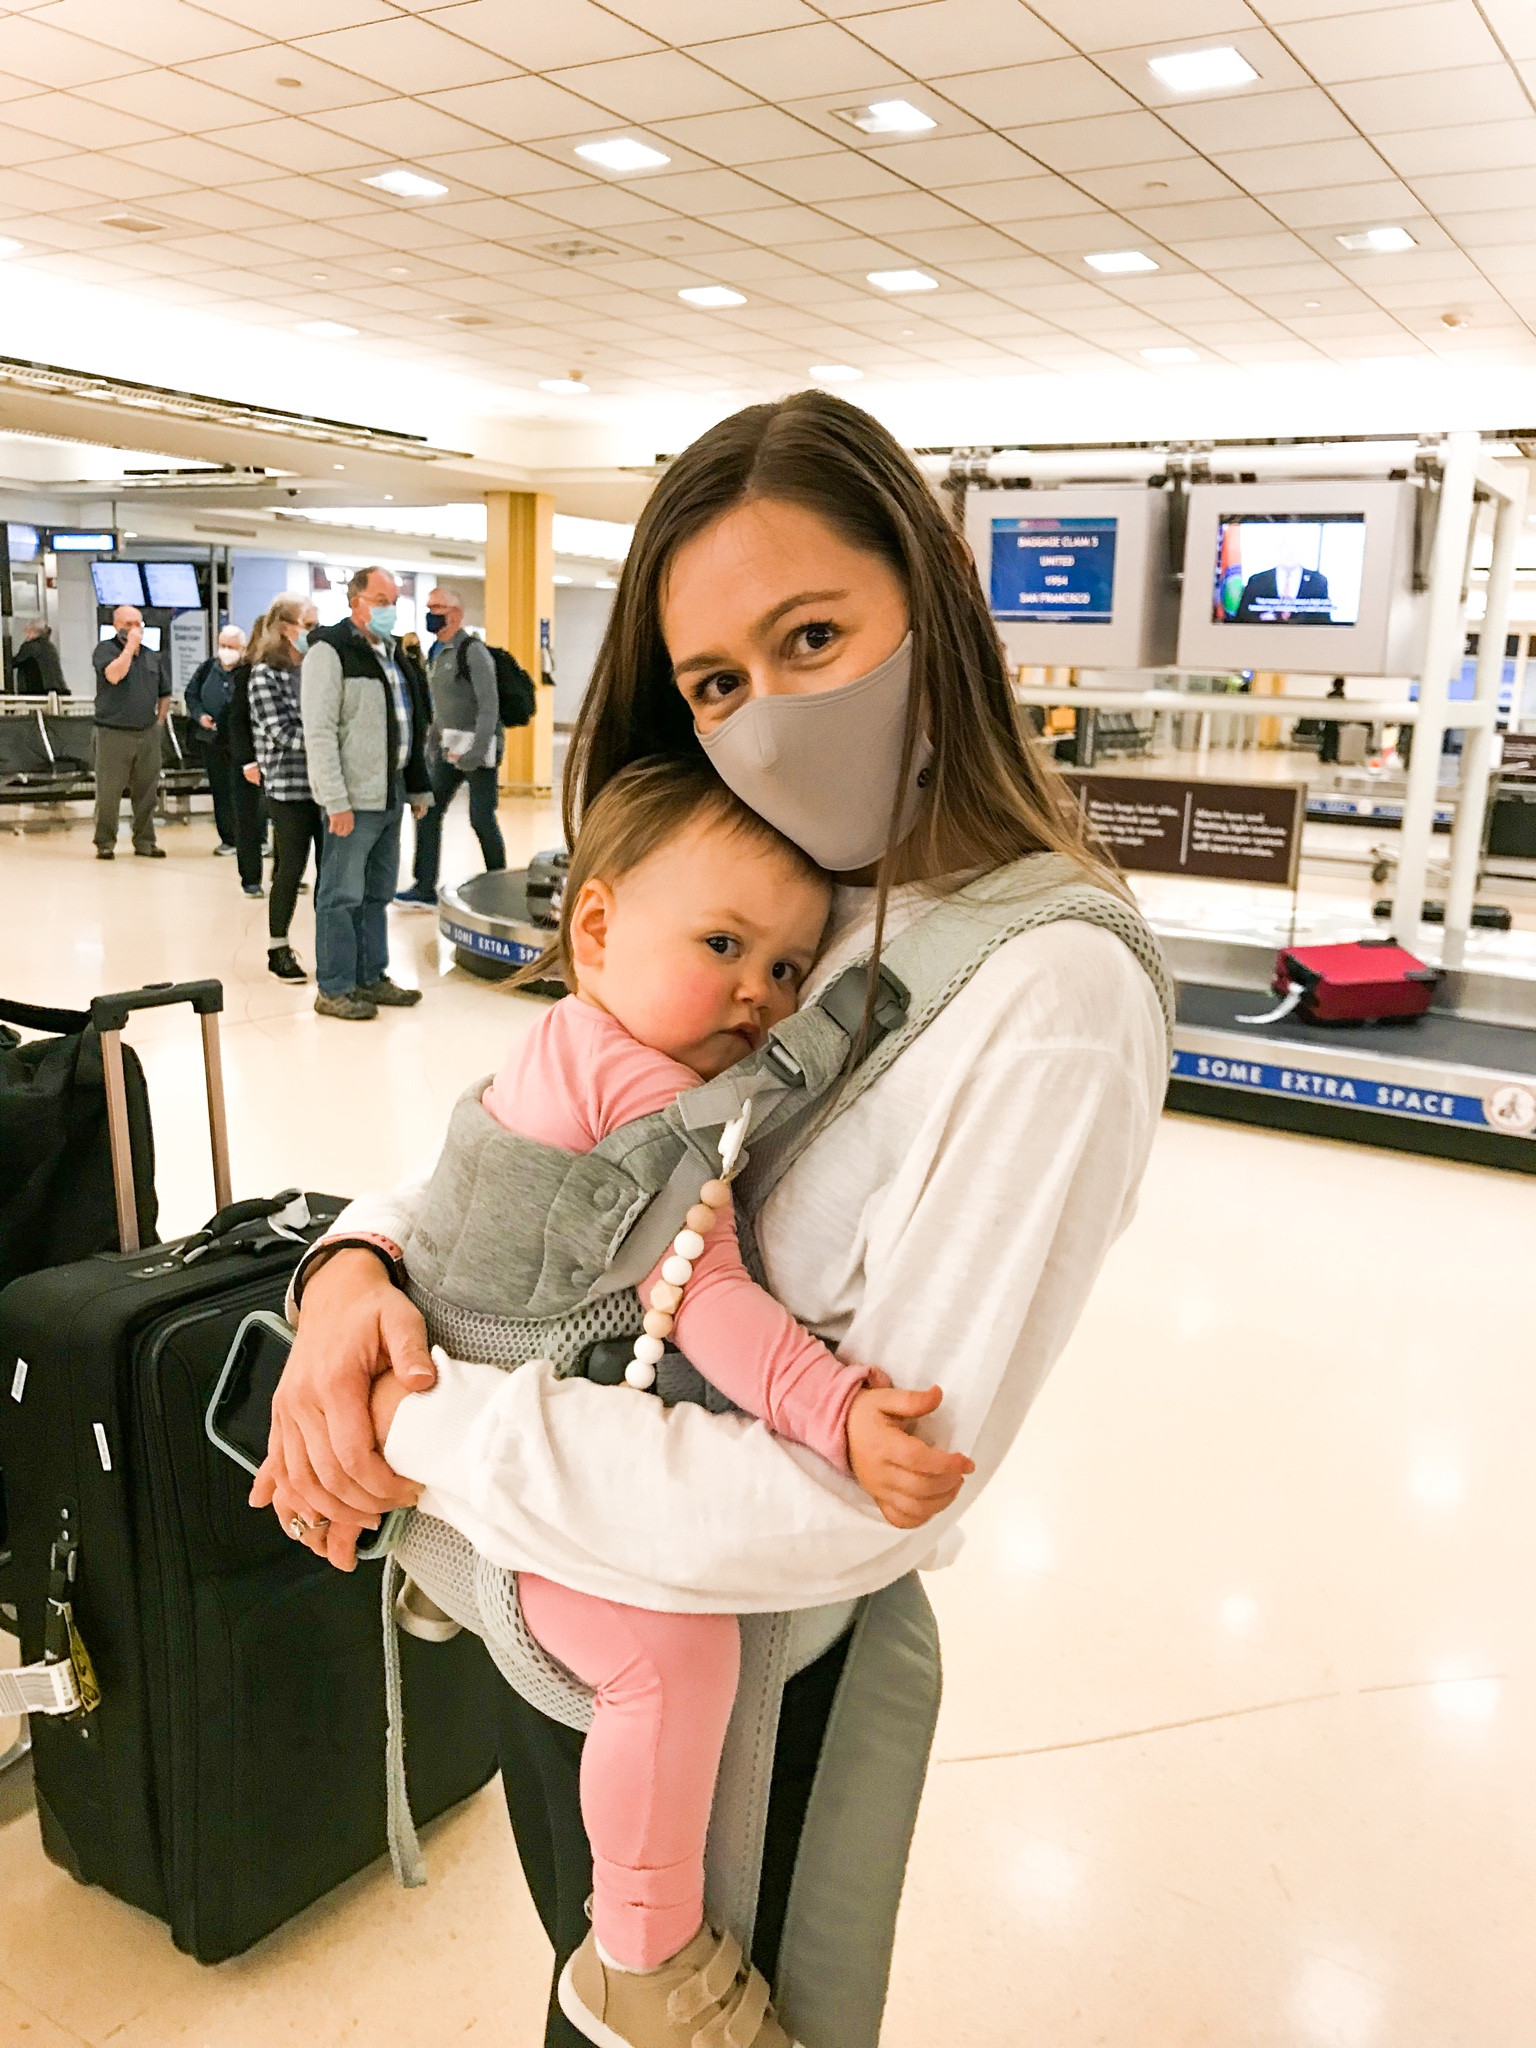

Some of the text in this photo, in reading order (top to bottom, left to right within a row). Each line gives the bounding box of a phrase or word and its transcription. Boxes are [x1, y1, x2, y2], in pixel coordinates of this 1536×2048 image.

[1017, 536, 1061, 548] BAGGAGE
[1061, 535, 1090, 548] CLAIM
[1039, 554, 1075, 567] UNITED
[1019, 592, 1091, 605] SAN FRANCISCO
[454, 928, 541, 960] SOME EXTRA SPA
[1198, 1058, 1262, 1084] SOME
[1281, 1071, 1357, 1101] EXTRA
[1376, 1086, 1455, 1116] SPACE
